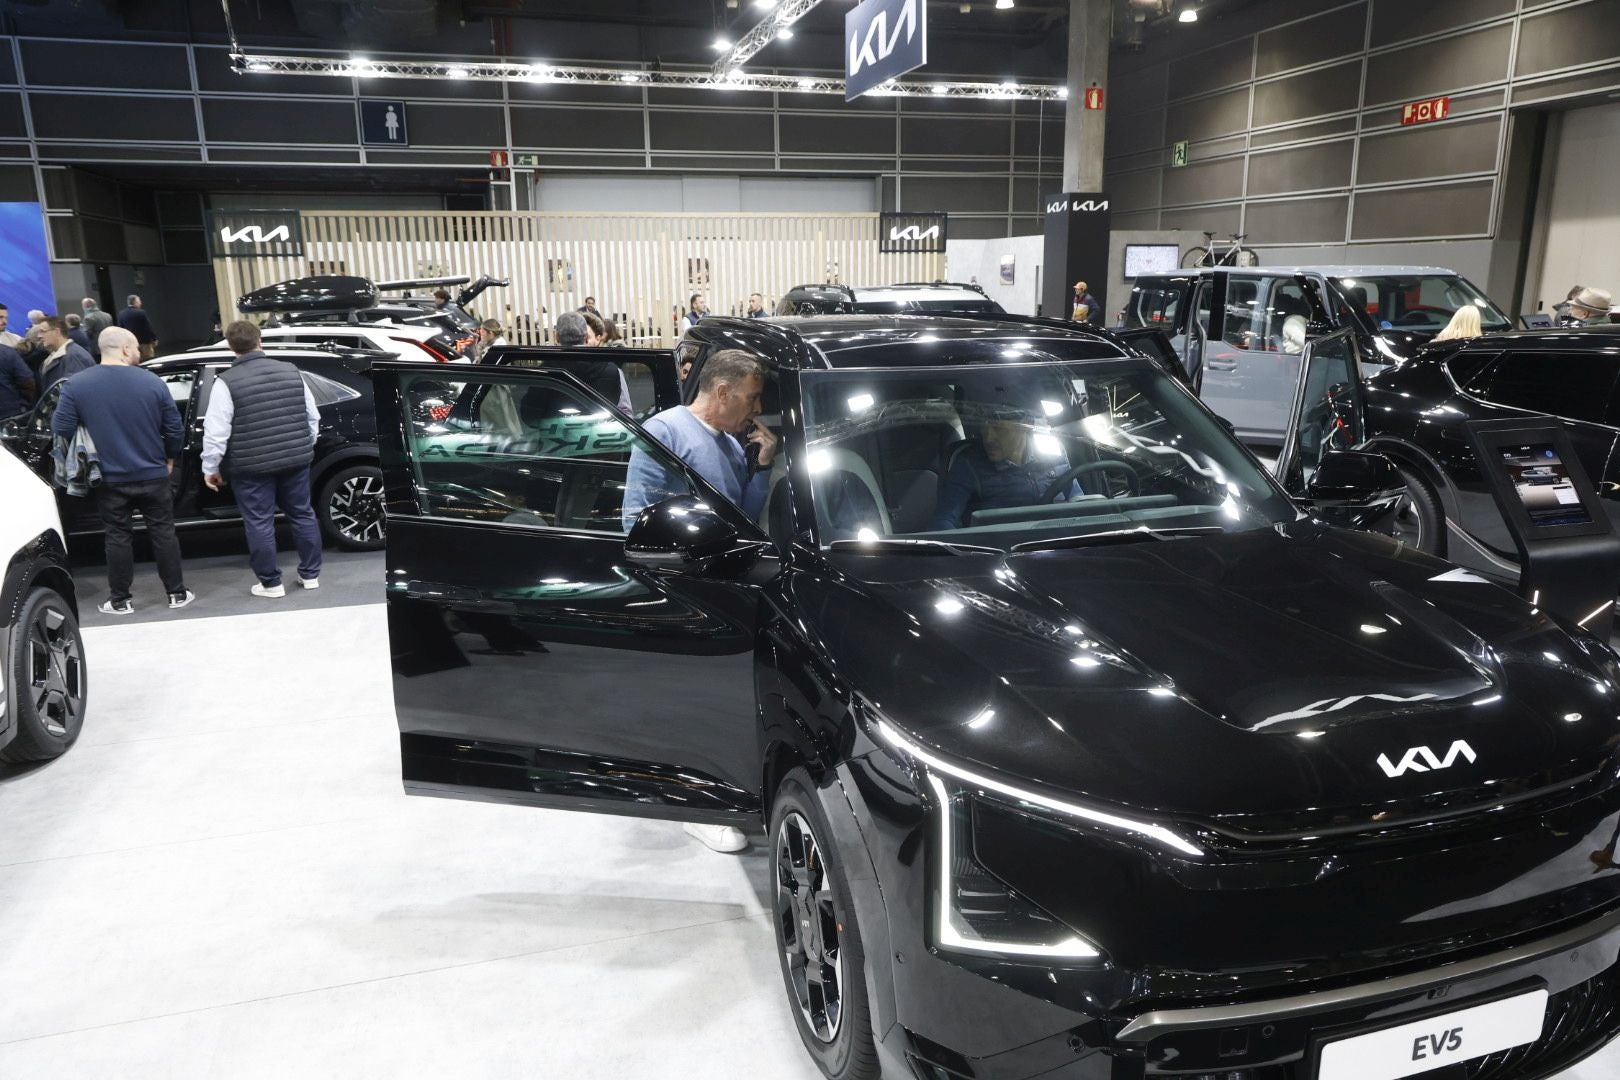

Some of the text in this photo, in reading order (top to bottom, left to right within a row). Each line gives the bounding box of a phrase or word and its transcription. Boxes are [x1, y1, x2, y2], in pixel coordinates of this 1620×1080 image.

[850, 0, 917, 77] KIA
[1046, 200, 1068, 214] KIA
[1072, 200, 1109, 211] KIA
[221, 225, 289, 242] KIA
[890, 225, 939, 240] KIA
[1376, 739, 1477, 778] KIA
[1411, 1026, 1464, 1061] EV5
